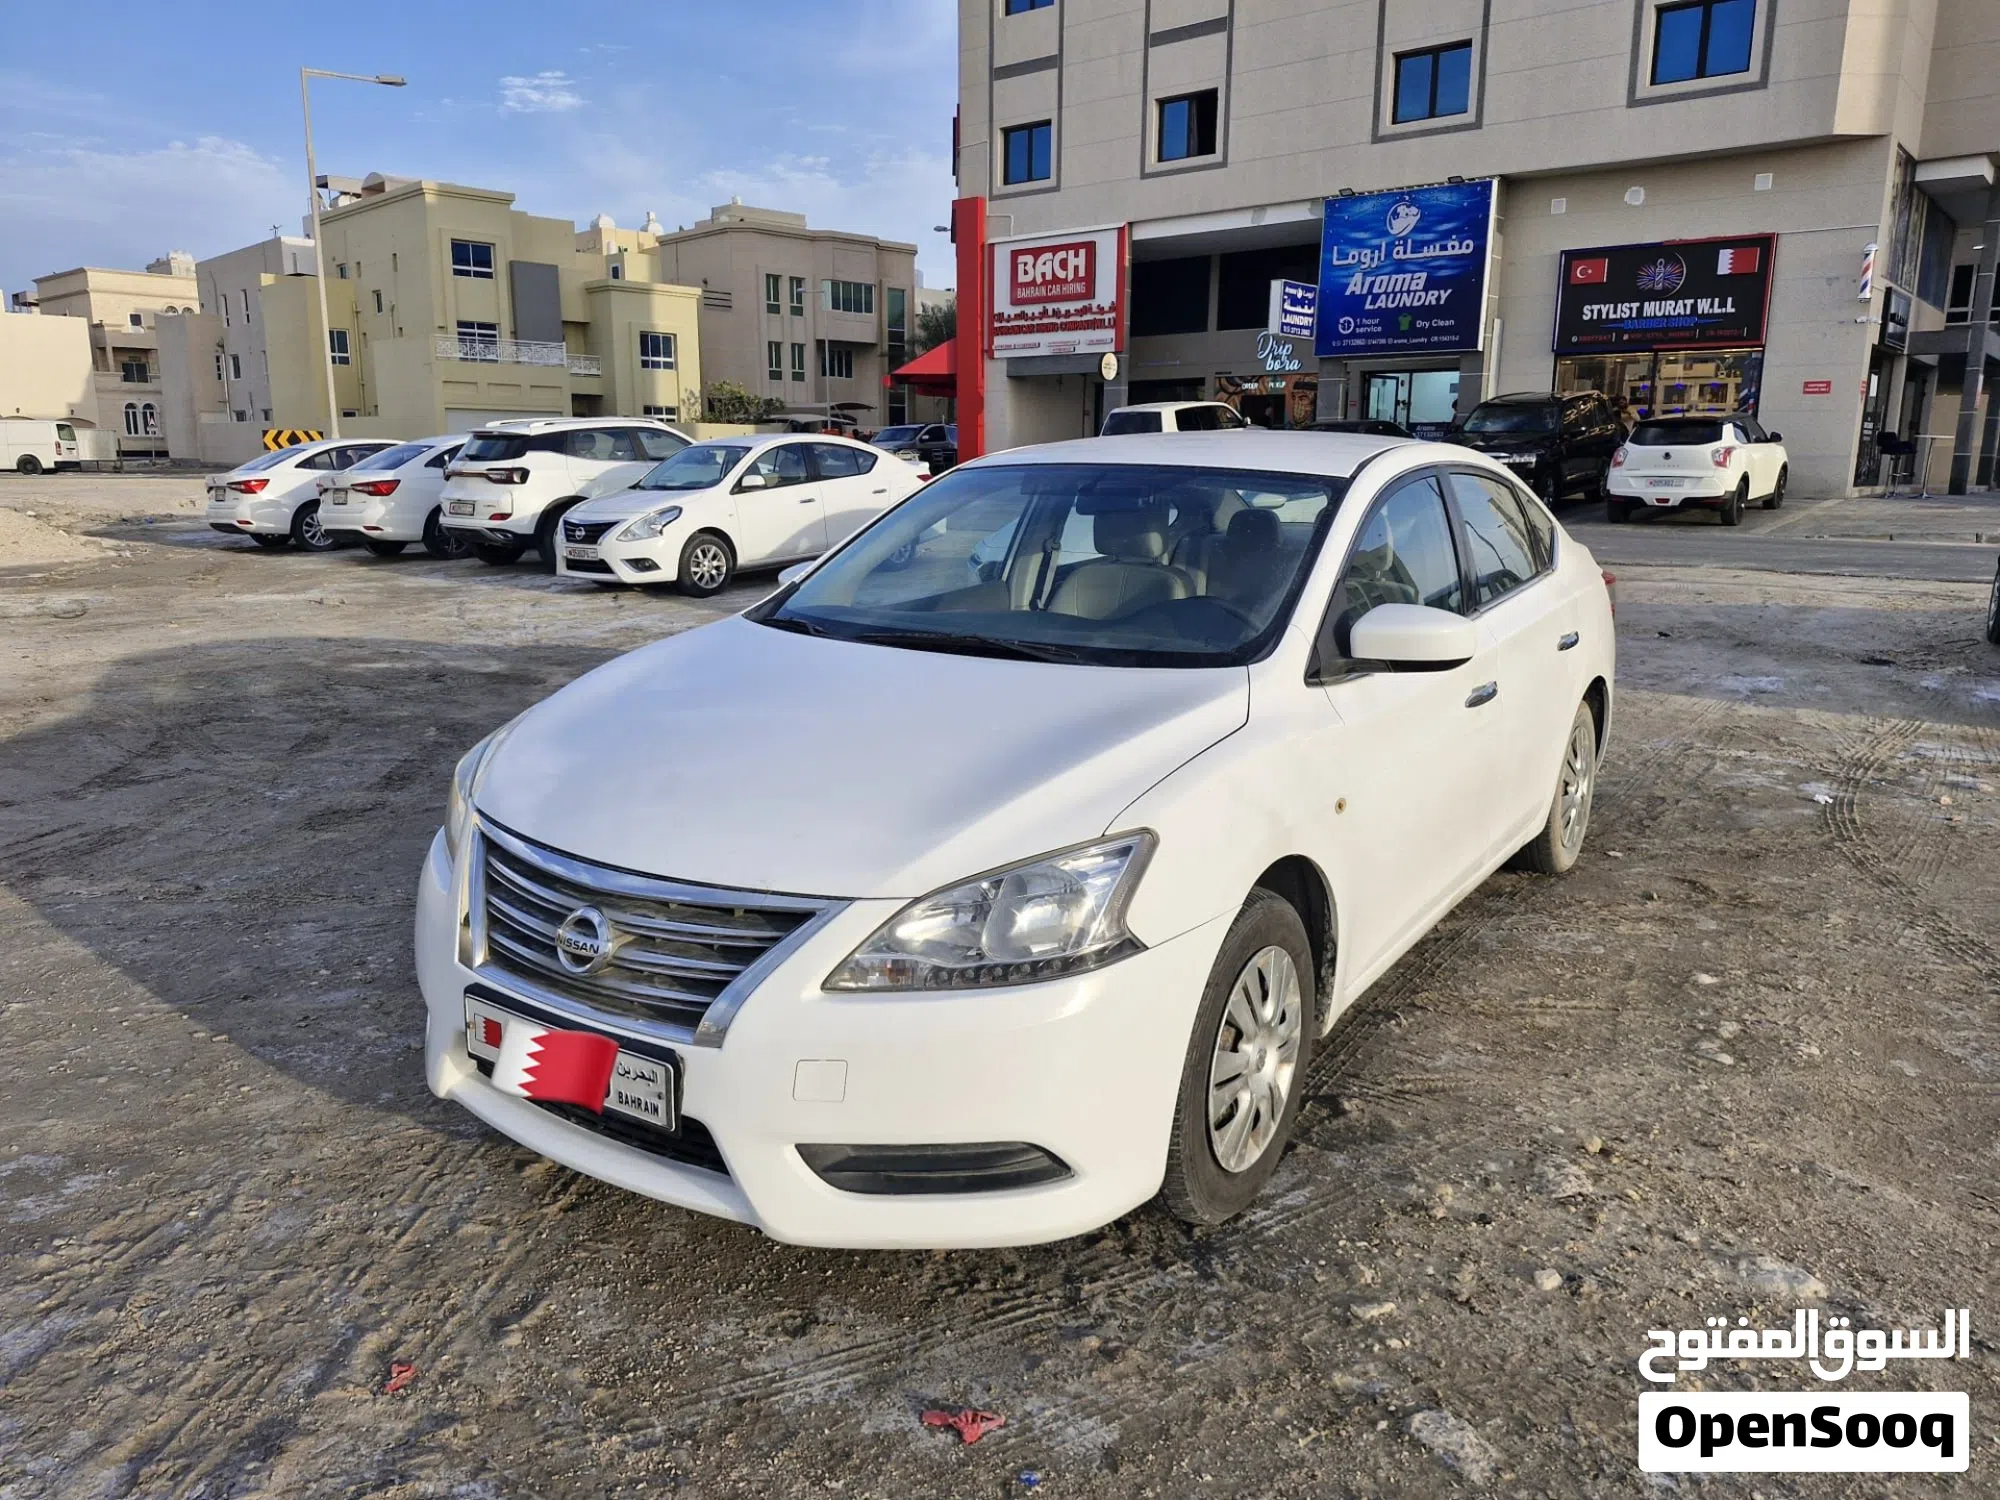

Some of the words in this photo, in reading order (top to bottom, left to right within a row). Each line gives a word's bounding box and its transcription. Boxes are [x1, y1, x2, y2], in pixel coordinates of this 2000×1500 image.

[1332, 240, 1386, 269] اروما
[1392, 235, 1474, 259] مغسلة
[1017, 249, 1086, 285] BACH
[1017, 285, 1047, 298] BAHRAIN
[1047, 284, 1060, 296] CAR
[1061, 282, 1086, 295] HIRING
[1345, 272, 1428, 295] Aroma
[1364, 289, 1453, 310] LAUNDRY
[1582, 303, 1640, 320] STYLIST
[1643, 300, 1694, 317] MURAT
[1697, 297, 1736, 314] W.L.L
[1282, 312, 1313, 327] LAUNDRY
[1356, 325, 1382, 333] service
[1416, 320, 1430, 328] Dry
[1432, 318, 1455, 326] Clean
[1257, 331, 1293, 362] Drip
[556, 933, 600, 954] NISSAN
[616, 1059, 659, 1085] البحرين
[617, 1090, 660, 1117] BAHRAIN
